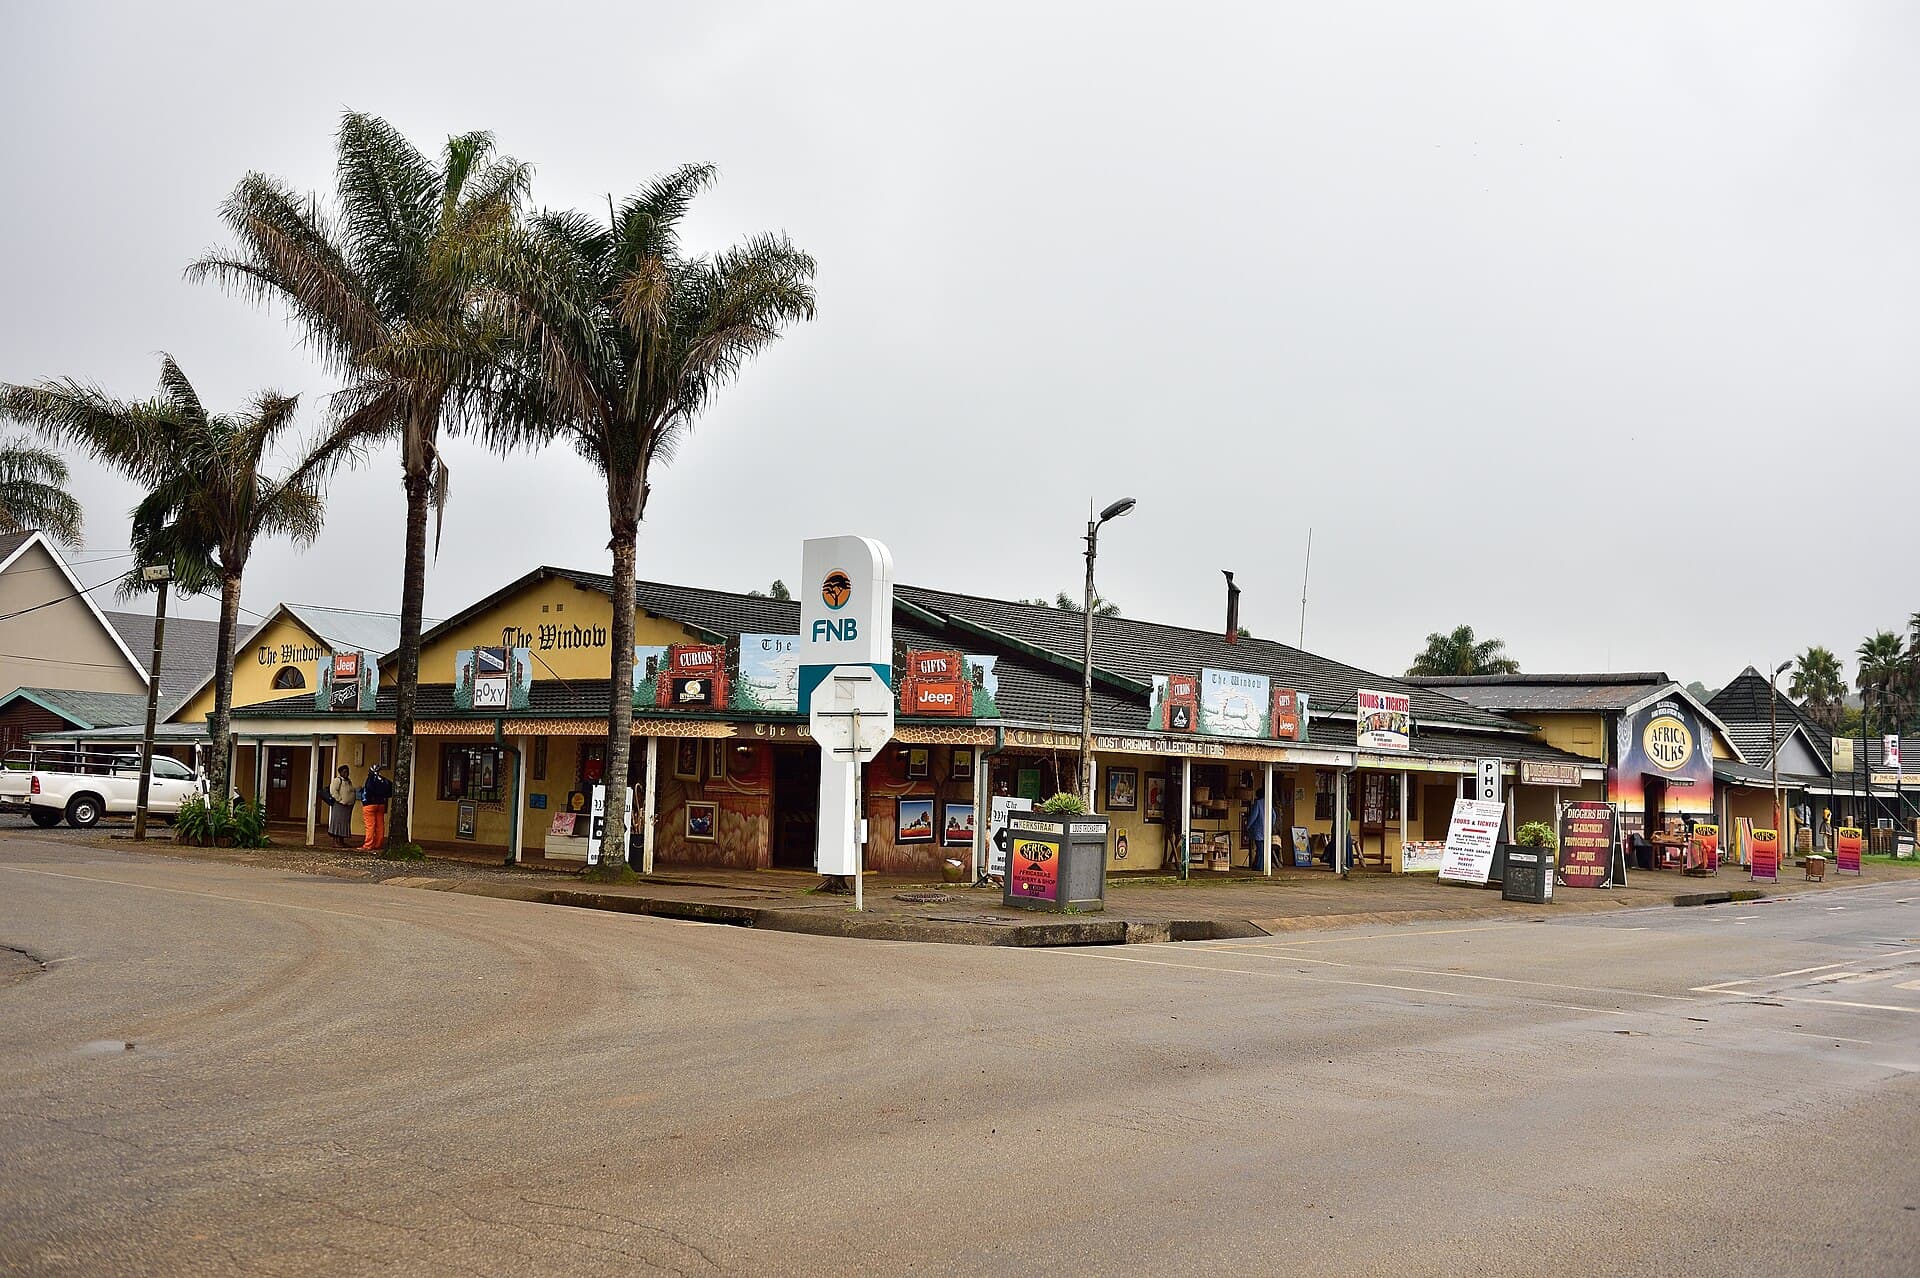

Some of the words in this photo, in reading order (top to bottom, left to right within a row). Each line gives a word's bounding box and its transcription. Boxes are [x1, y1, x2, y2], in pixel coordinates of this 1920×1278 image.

[502, 626, 532, 649] The
[538, 623, 607, 650] Window
[812, 618, 858, 642] FNB
[761, 638, 792, 652] The
[258, 646, 278, 668] The
[680, 650, 713, 667] CURIOS
[336, 660, 356, 672] Jeep
[920, 658, 947, 673] GIFTS
[1211, 673, 1226, 685] The
[1231, 675, 1262, 689] Window
[475, 683, 505, 703] ROXY
[919, 691, 954, 705] Jeep
[1358, 693, 1379, 709] TOURS
[1380, 697, 1384, 709] &
[1385, 696, 1409, 712] TICKETS
[755, 724, 786, 738] The
[1280, 719, 1295, 732] Jeep
[1017, 731, 1037, 744] The
[1651, 727, 1686, 745] AFRICA
[1098, 736, 1119, 749] MOST
[1122, 738, 1154, 751] ORIGINAL
[1155, 741, 1202, 754] COLLECTABLE
[1204, 744, 1225, 756] ITEMS
[1653, 742, 1684, 762] SILKS
[1567, 808, 1596, 819] DIGGERS
[1596, 810, 1611, 819] HUT
[1019, 820, 1055, 832] KERKSTRAAT
[1477, 820, 1499, 828] TICKETS
[1022, 843, 1052, 854] AFRICA
[1022, 850, 1051, 861] SILKS
